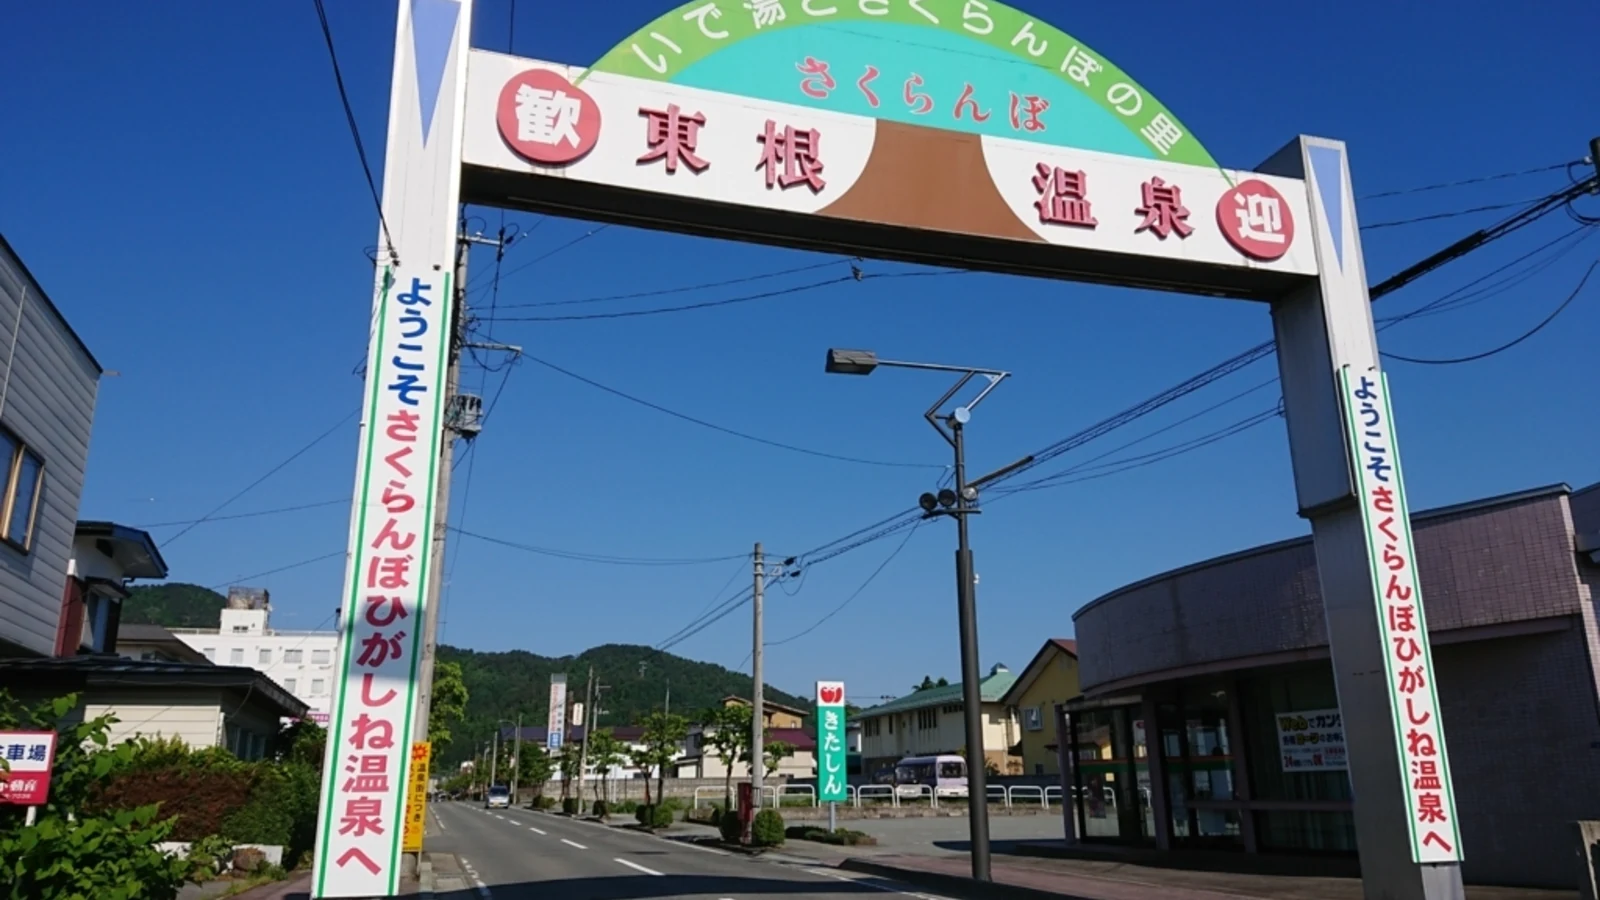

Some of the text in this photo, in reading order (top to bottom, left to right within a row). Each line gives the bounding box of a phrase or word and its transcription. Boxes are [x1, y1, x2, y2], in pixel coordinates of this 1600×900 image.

[794, 55, 1051, 133] さくらんぼ
[513, 82, 583, 150] 歓
[1234, 191, 1286, 245] 迎
[824, 710, 842, 795] きたしん
